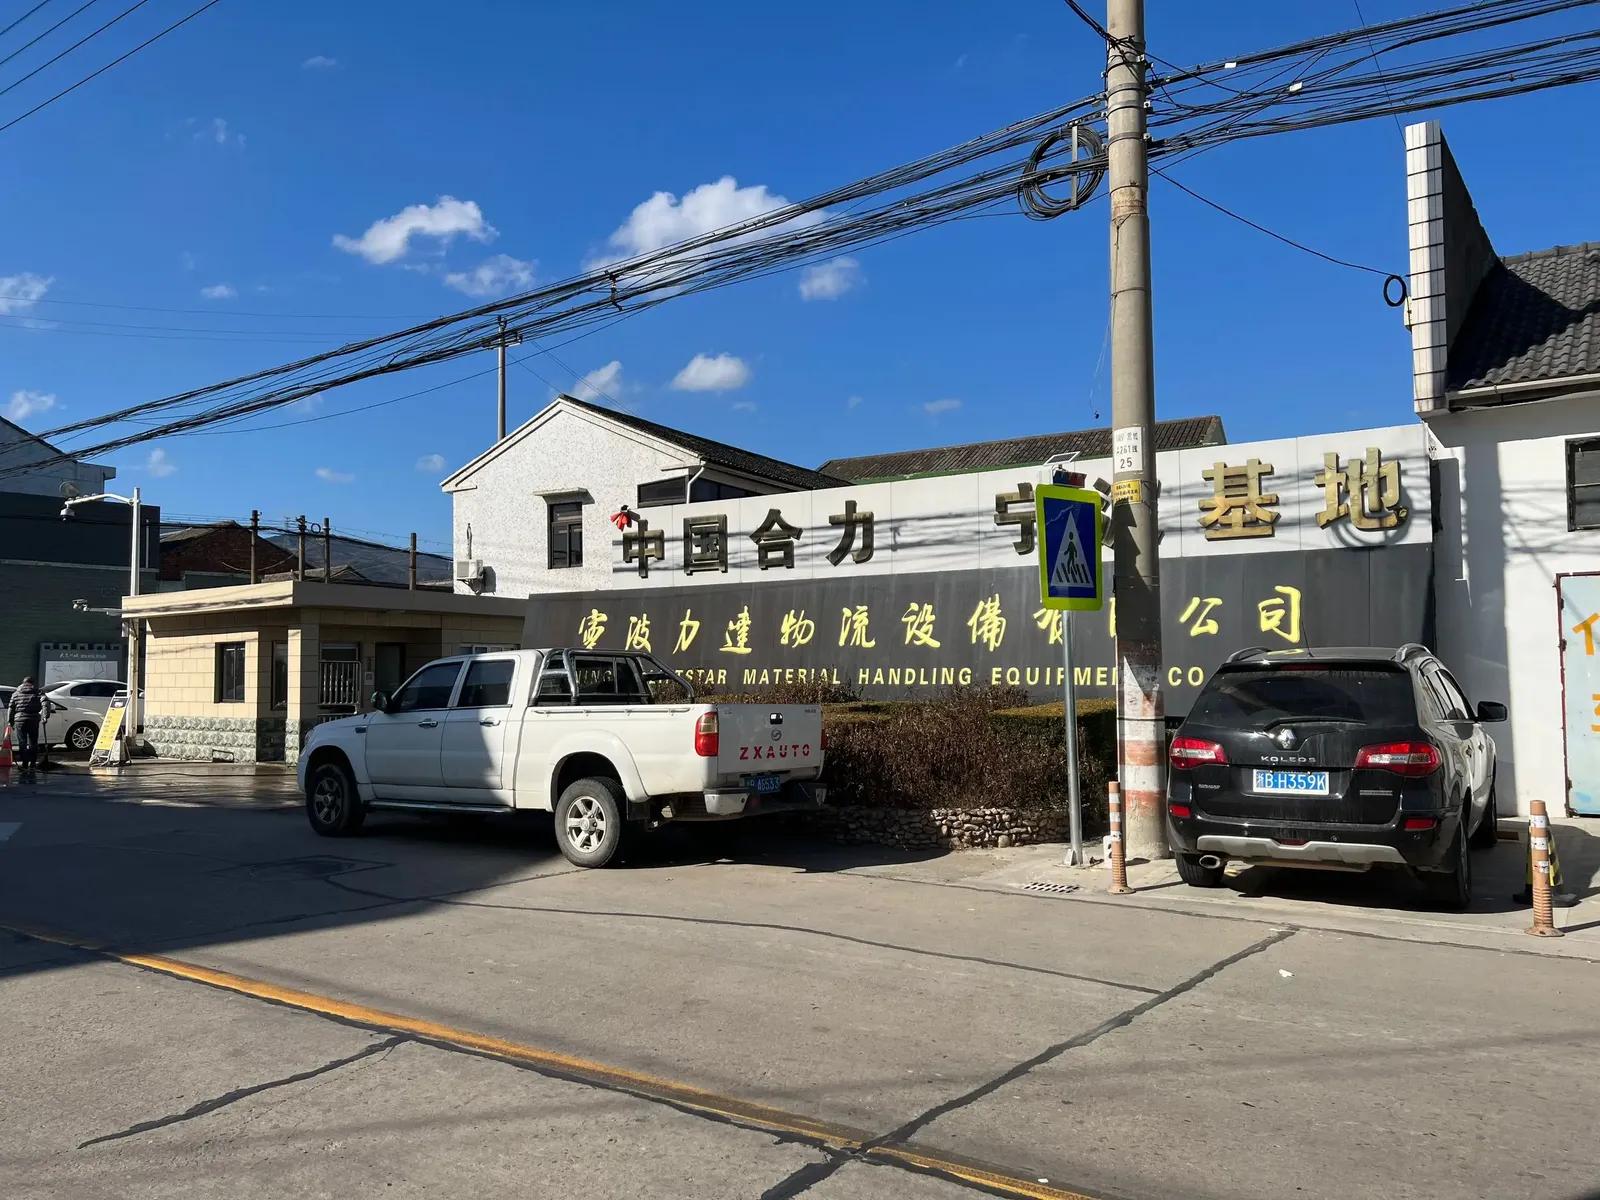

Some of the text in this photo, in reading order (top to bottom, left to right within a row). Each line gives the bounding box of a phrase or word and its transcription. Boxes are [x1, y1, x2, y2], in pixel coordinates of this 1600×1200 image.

[1120, 457, 1133, 469] 25
[622, 447, 1408, 578] 中国合力 宁基地
[743, 668, 841, 685] MATERIAL
[858, 667, 972, 685] HANDLING
[991, 666, 1118, 686] EQUIPME
[739, 743, 811, 760] ZXAUTO
[1260, 755, 1317, 763] KOLEOS
